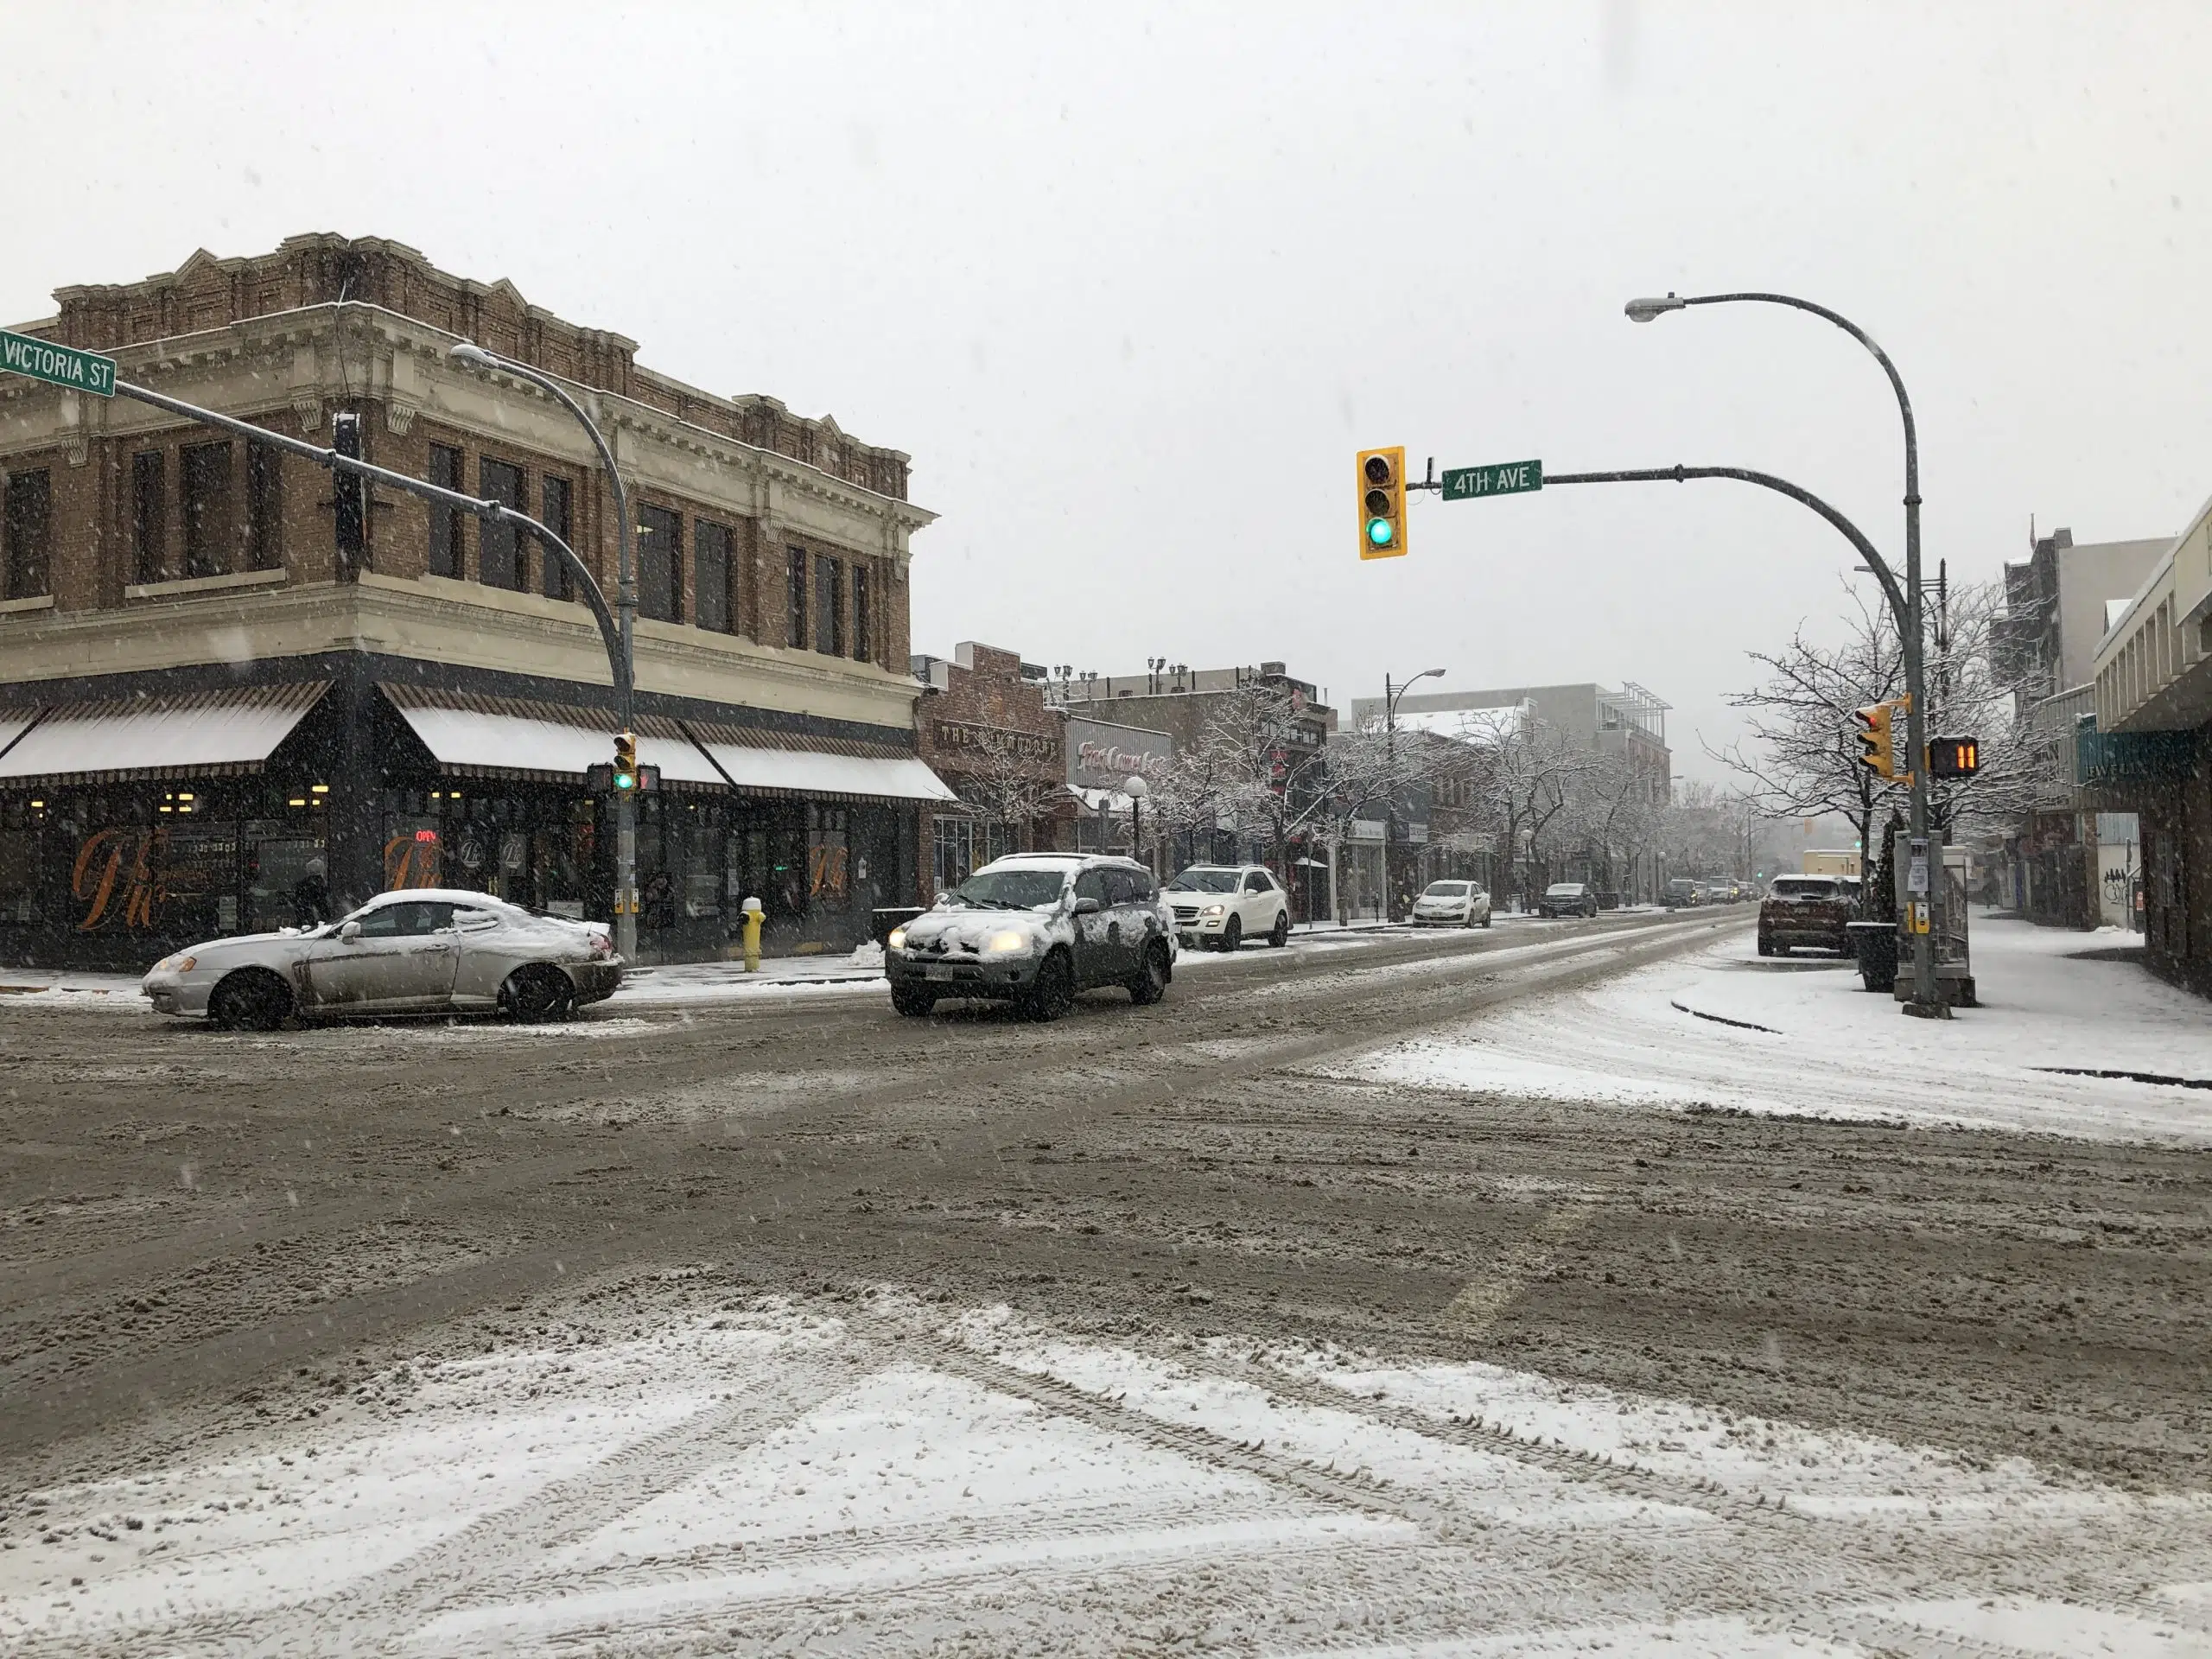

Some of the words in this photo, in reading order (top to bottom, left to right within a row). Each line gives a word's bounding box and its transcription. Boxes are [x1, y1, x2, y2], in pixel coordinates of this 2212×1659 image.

[3, 337, 84, 382] VICTORIA
[89, 363, 111, 389] ST
[1453, 471, 1488, 493] 4TH
[1497, 466, 1530, 490] AVE
[941, 726, 969, 744] THE
[416, 830, 436, 842] OPEN
